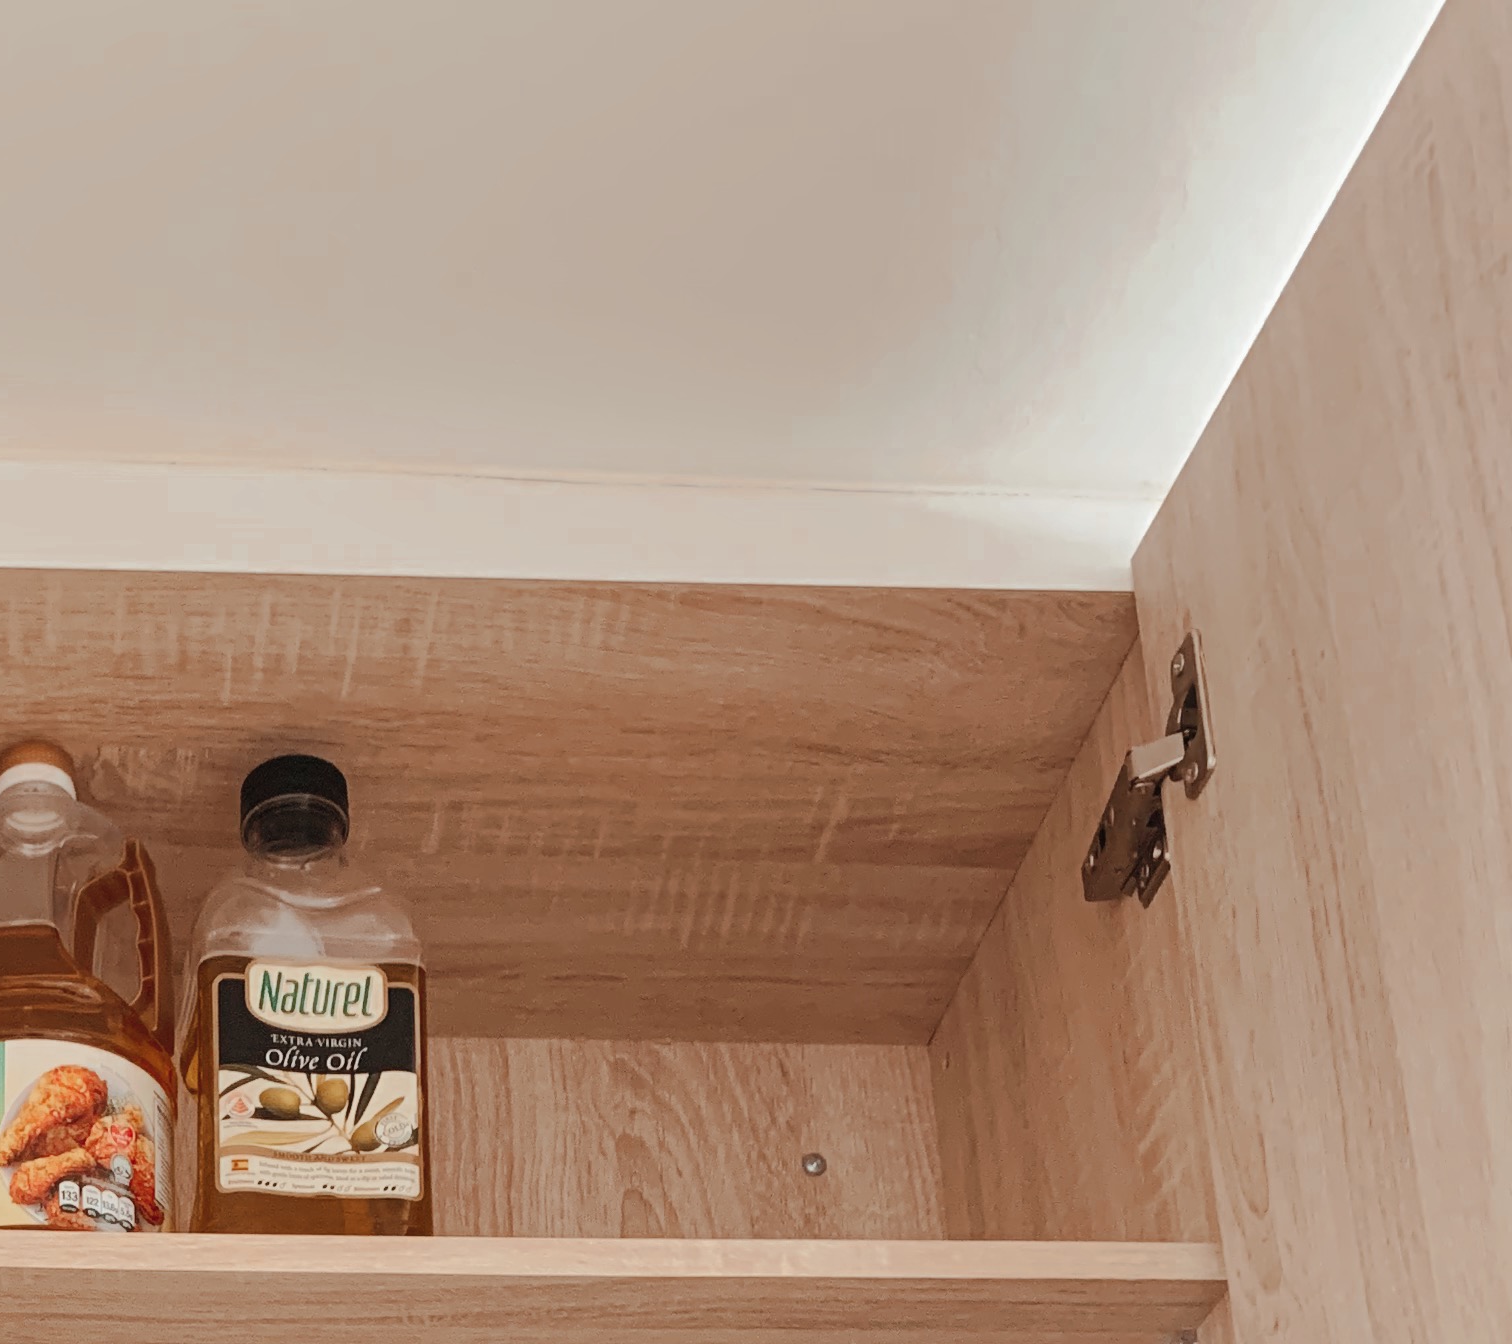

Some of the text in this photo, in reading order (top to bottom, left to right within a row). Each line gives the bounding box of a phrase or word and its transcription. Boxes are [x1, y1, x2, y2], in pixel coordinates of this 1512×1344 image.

[258, 970, 373, 1018] Naturel
[270, 1034, 362, 1048] EXTRA VIRGIN
[265, 1045, 368, 1071] Olive Oil
[61, 1189, 78, 1202] 133
